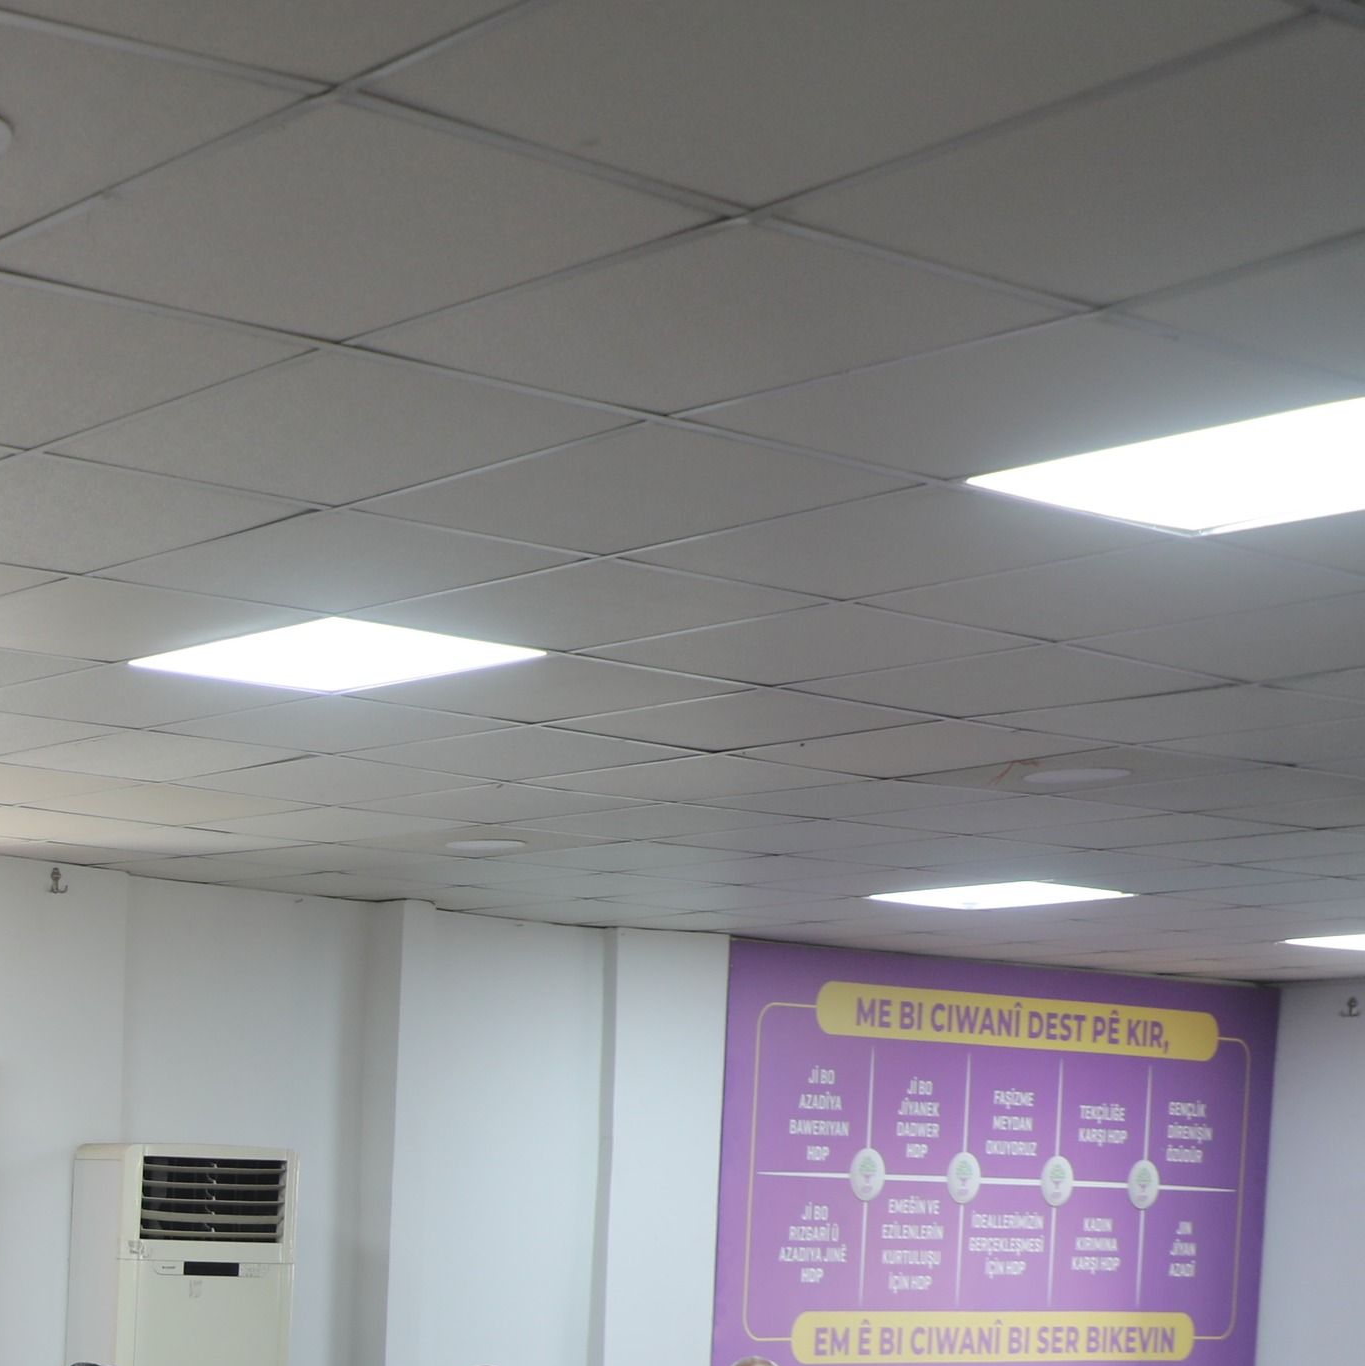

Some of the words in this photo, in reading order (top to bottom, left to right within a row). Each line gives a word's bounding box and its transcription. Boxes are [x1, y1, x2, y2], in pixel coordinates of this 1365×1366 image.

[855, 997, 892, 1029] ME
[899, 1000, 924, 1031] BI
[930, 1003, 1021, 1039] CIWANÎ
[1027, 1010, 1086, 1042] DEST
[1092, 1010, 1119, 1045] PÊ
[1126, 1019, 1170, 1054] KIR,
[820, 1069, 836, 1085] BO
[919, 1080, 933, 1095] BO
[993, 1087, 1035, 1109] FAŞİZME
[1169, 1100, 1207, 1120] GENÇLİK
[895, 1121, 940, 1138] DADWER
[992, 1115, 1034, 1132] MEYDAN
[1078, 1128, 1107, 1147] KARŞI
[1108, 1129, 1128, 1144] HDP
[806, 1145, 830, 1161] HDP
[905, 1143, 929, 1158] HDP
[985, 1139, 1038, 1156] OKUYORUZ
[813, 1205, 829, 1221] BO
[888, 1196, 926, 1215] EMEĞİN
[927, 1199, 941, 1215] VE
[881, 1221, 945, 1240] EZİLENLERİN
[1083, 1217, 1114, 1232] KADIN
[881, 1249, 942, 1269] KURTULUŞU
[984, 1257, 1007, 1279] İÇİN
[1006, 1260, 1027, 1276] HDP
[1071, 1256, 1099, 1275] KARŞI
[1099, 1257, 1121, 1272] HDP
[800, 1267, 824, 1283] HDP
[887, 1272, 910, 1294] İÇİN
[910, 1275, 933, 1290] HDP
[813, 1326, 850, 1356] EM
[856, 1318, 871, 1356] Ê
[879, 1326, 904, 1356] BI
[909, 1318, 1004, 1355] CIWANÎ
[1007, 1326, 1031, 1355] BI
[1036, 1326, 1080, 1354] SER
[1086, 1325, 1176, 1354] BIKEVIN
